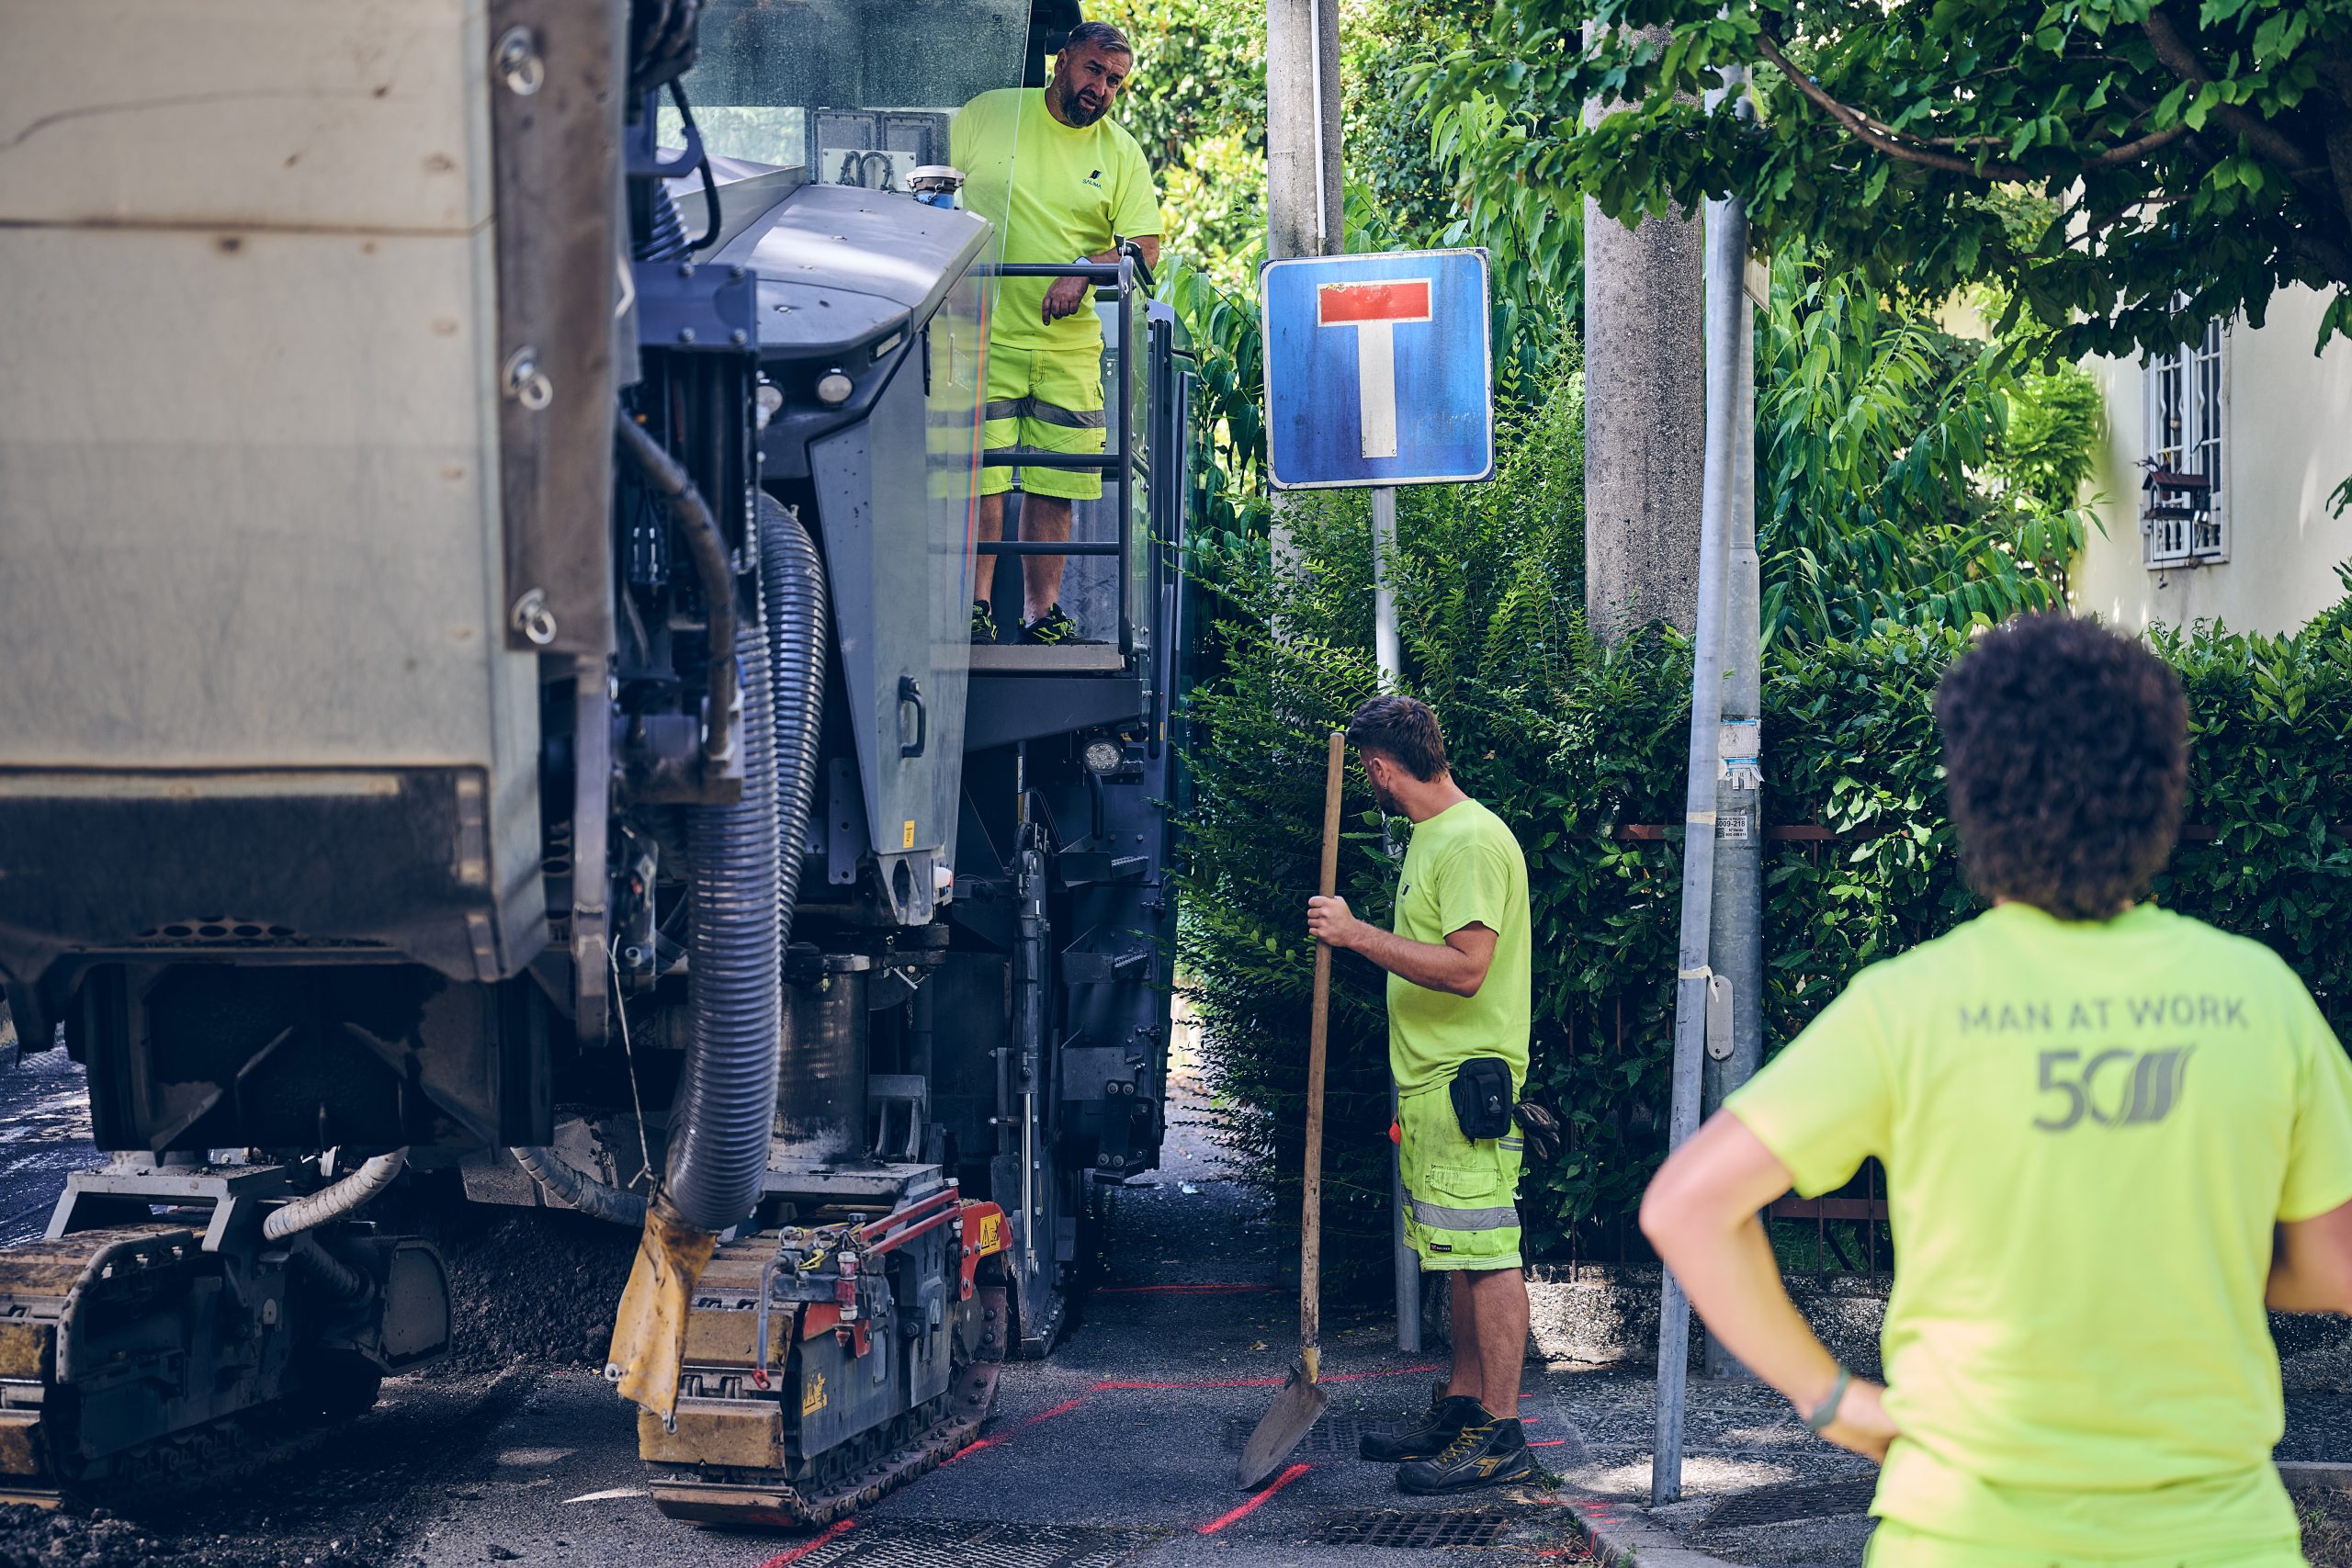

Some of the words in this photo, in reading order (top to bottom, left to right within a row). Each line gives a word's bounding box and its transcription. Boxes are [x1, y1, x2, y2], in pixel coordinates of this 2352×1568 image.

[1959, 1003, 2052, 1033] MAN
[2068, 998, 2112, 1031] AT
[2128, 994, 2248, 1028] WORK
